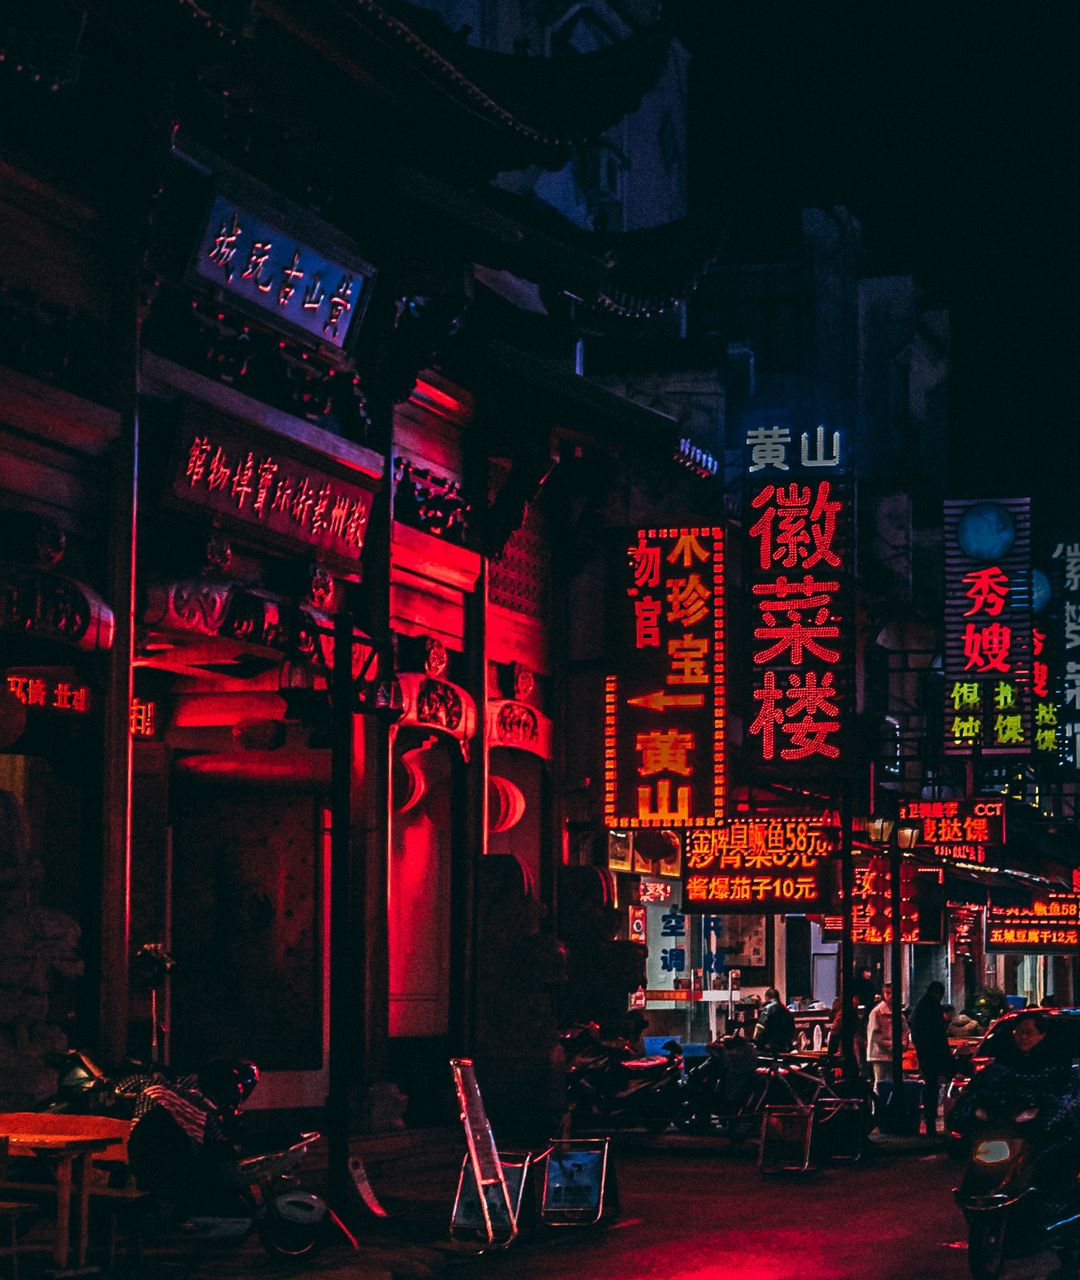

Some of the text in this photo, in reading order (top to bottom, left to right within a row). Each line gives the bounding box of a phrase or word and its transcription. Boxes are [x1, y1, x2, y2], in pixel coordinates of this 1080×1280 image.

[746, 426, 841, 473] 黄山
[748, 480, 842, 762] 徽菜楼
[961, 565, 1012, 673] 秀嫂
[635, 730, 694, 821] 黄山
[687, 876, 818, 900] 酱爆茄子10元
[661, 904, 685, 972] 空调
